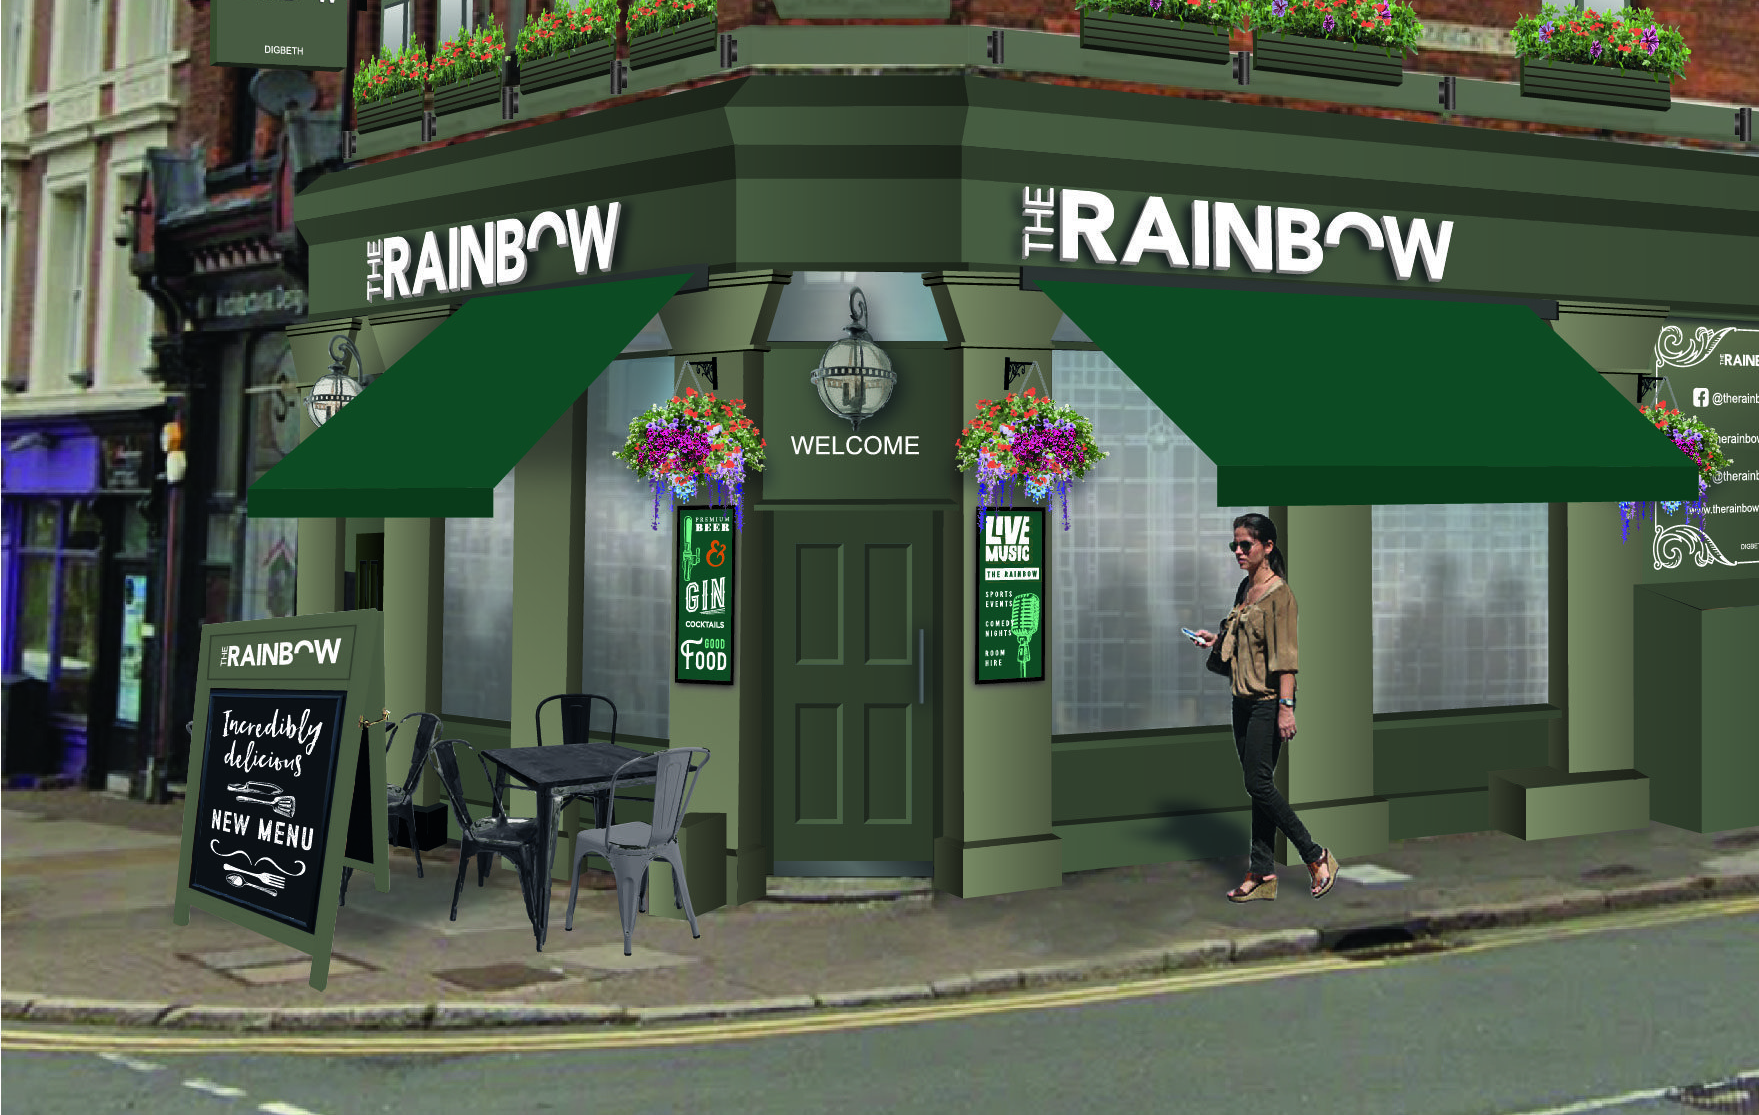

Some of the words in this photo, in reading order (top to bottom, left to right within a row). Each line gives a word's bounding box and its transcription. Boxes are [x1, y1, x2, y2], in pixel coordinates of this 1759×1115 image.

[264, 45, 304, 56] DIGBETH
[1022, 186, 1055, 260] THE
[1059, 188, 1454, 283] RAINBOW
[366, 238, 383, 304] THE
[383, 201, 622, 301] RAINBOW
[790, 435, 920, 455] WELCOME
[695, 523, 730, 532] BEER
[985, 516, 1030, 545] LIVE
[985, 545, 1030, 562] MUSIC
[987, 570, 1001, 579] THE
[1004, 570, 1038, 578] RAINBOW
[685, 576, 726, 613] GIN
[985, 590, 1013, 598] SPORTS
[985, 600, 1013, 608] EVENTS
[685, 620, 725, 629] COCKTAILS
[985, 629, 1012, 637] NIGHTS
[219, 645, 228, 667] THE
[227, 638, 342, 667] RAINBOW
[704, 638, 726, 650] GOOD
[680, 637, 727, 671] FOOD
[985, 649, 1006, 657] ROOM
[985, 658, 1003, 667] HIRE
[222, 708, 323, 756] Incredibly
[224, 740, 302, 777] delicious
[211, 808, 250, 836] NEW
[257, 817, 314, 851] MENU
